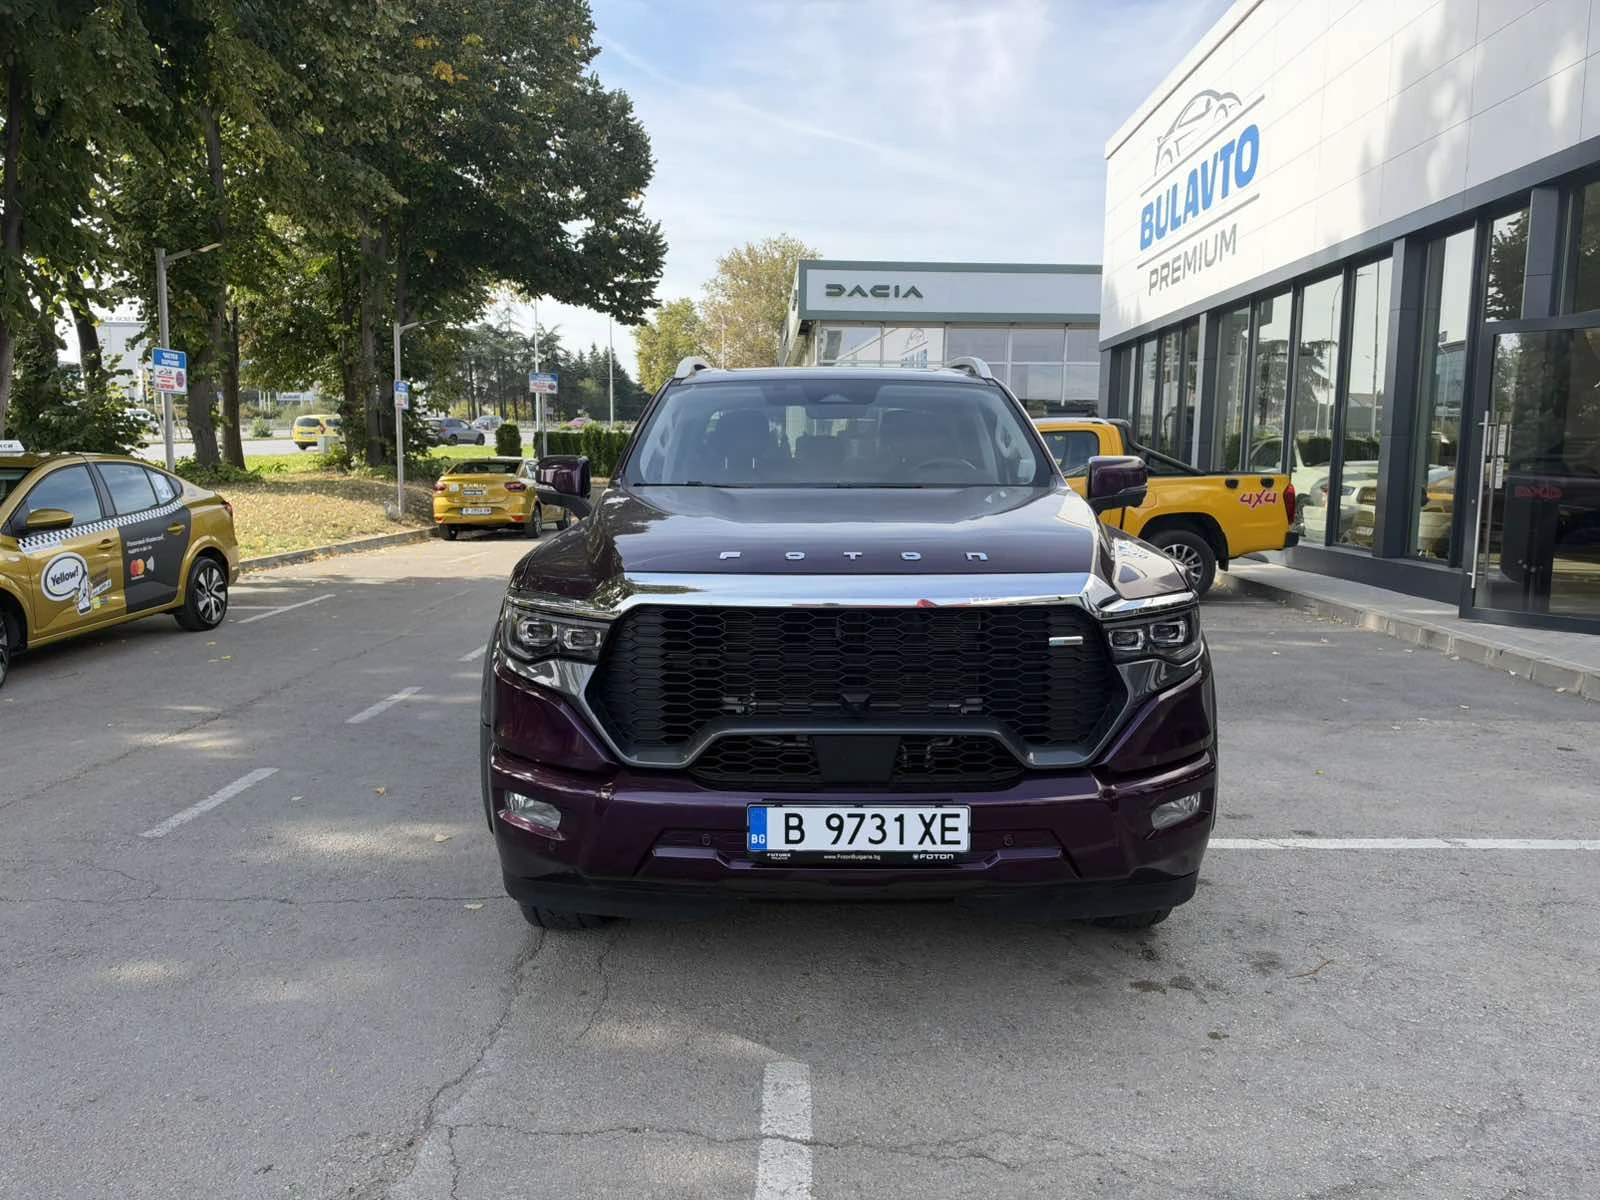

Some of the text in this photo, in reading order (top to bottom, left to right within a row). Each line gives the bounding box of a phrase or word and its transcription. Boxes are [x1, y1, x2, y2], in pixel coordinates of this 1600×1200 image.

[1139, 123, 1260, 251] BULAVTO
[1148, 223, 1238, 297] PREMIUM
[825, 284, 923, 299] DACIA
[719, 551, 989, 561] FOTON
[51, 566, 78, 587] Yellow!
[751, 834, 766, 845] BG
[784, 813, 961, 846] B 9731 XE
